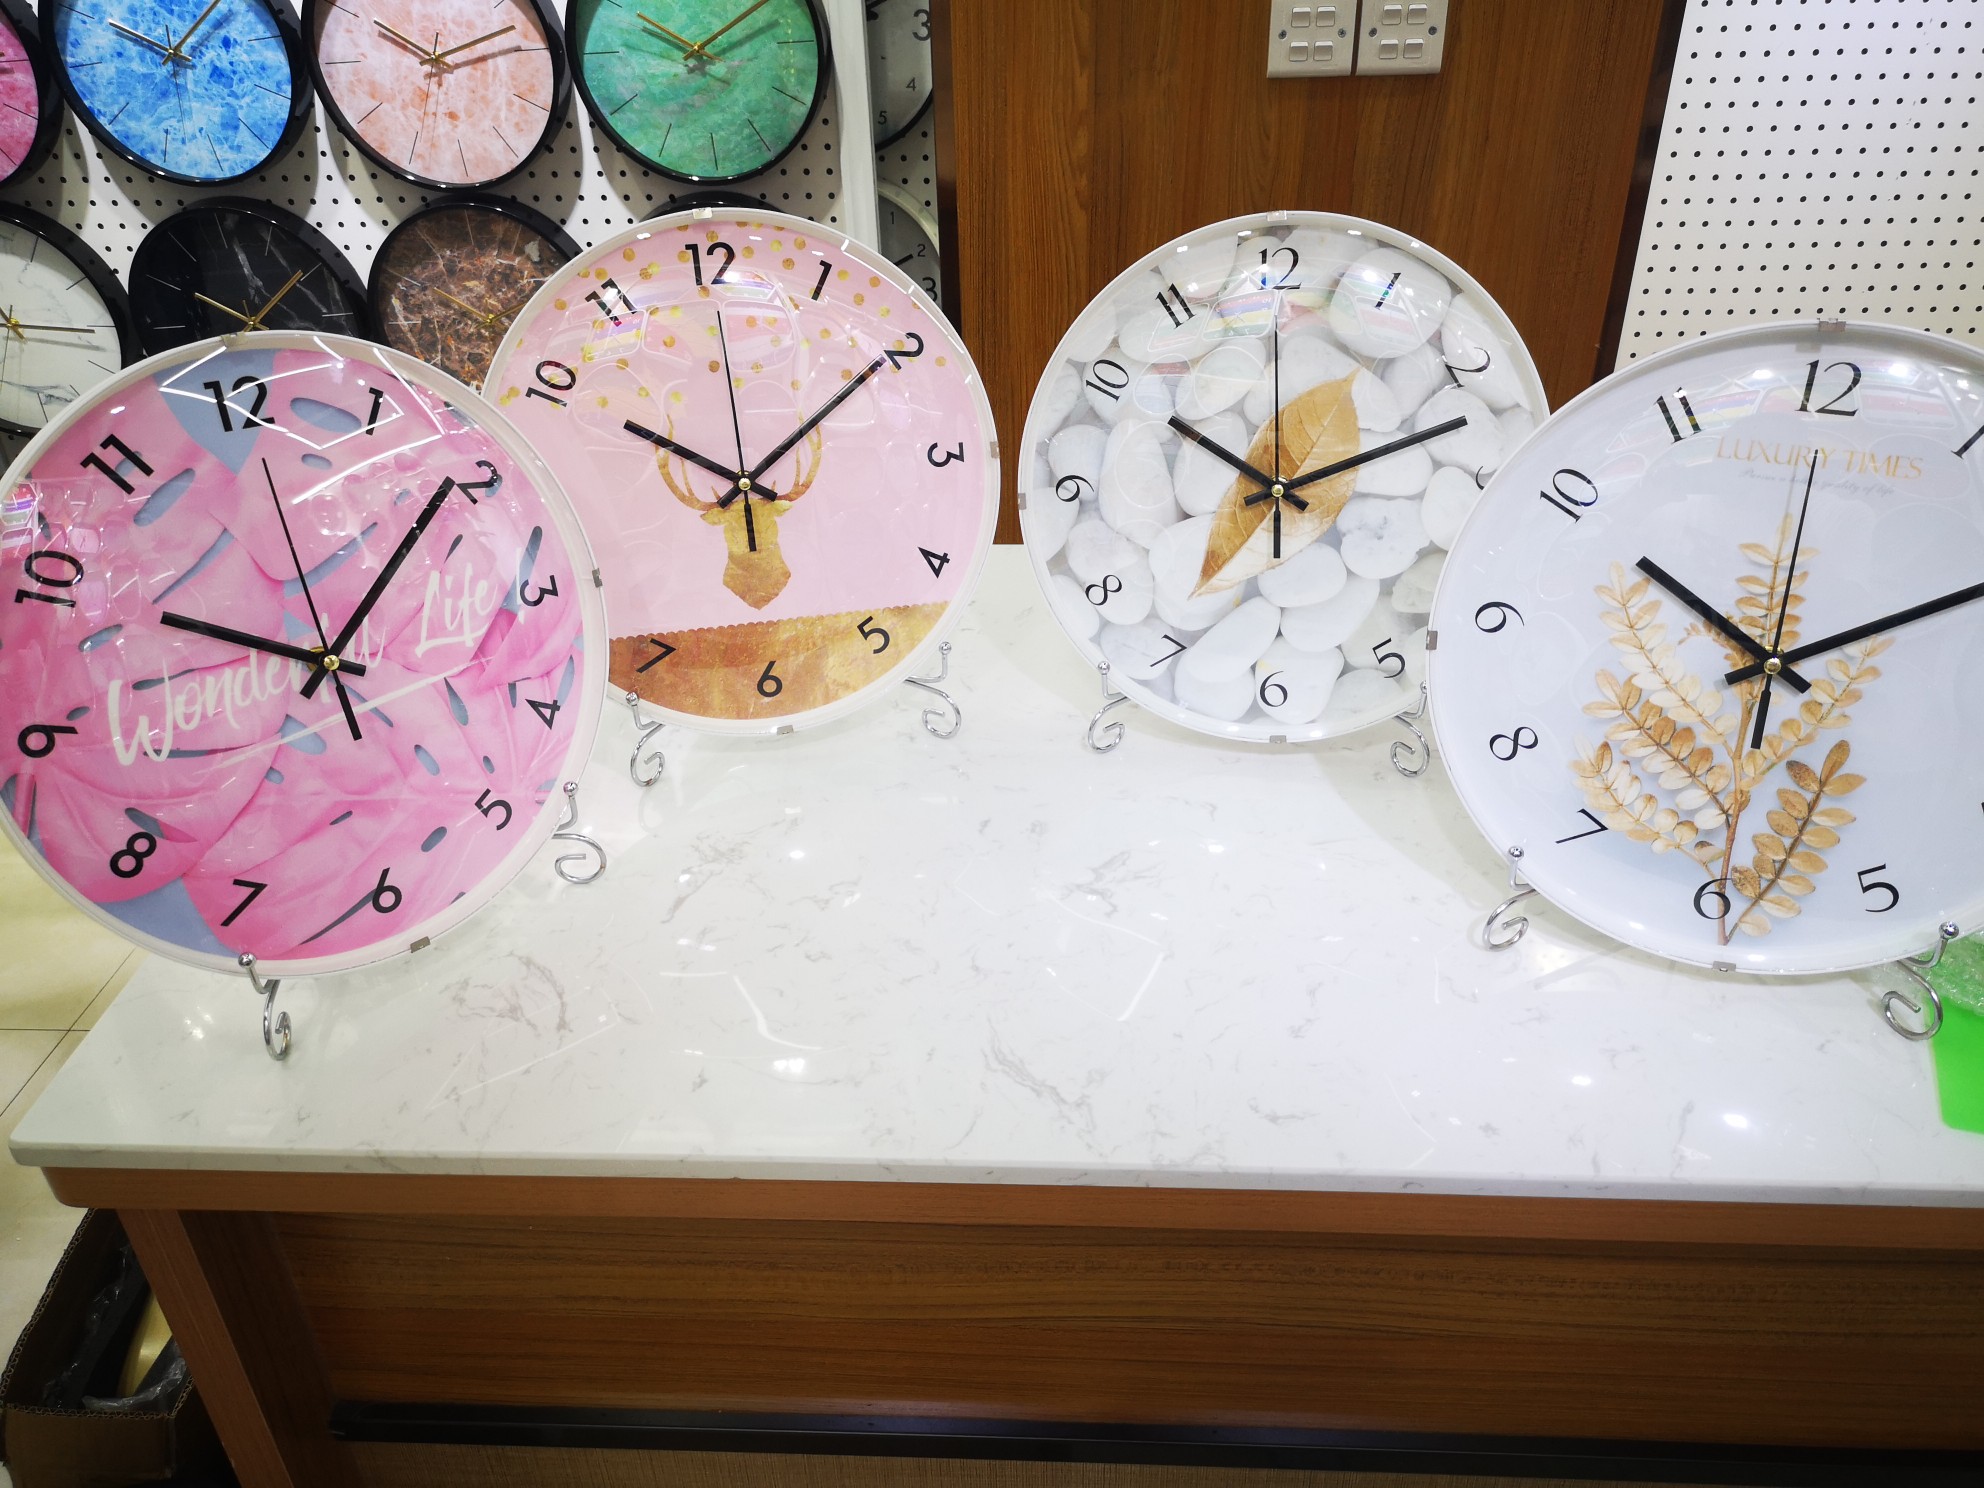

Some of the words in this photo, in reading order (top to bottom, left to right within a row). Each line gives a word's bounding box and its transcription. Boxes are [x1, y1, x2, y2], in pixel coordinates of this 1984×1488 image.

[912, 9, 931, 41] 3
[905, 77, 917, 92] 4
[877, 110, 887, 126] 5
[685, 242, 735, 285] 12
[917, 243, 926, 257] 2
[1258, 247, 1301, 291] 12
[812, 260, 832, 300] 1
[1374, 272, 1402, 309] 1
[584, 277, 638, 327] 11
[1156, 283, 1195, 328] 11
[884, 333, 923, 370] 2
[1444, 346, 1490, 389] 2
[526, 360, 576, 407] 10
[1086, 360, 1129, 400] 10
[1796, 359, 1862, 417] 12
[203, 376, 275, 432] 12
[366, 388, 383, 435] 1
[1655, 386, 1702, 445] 11
[80, 434, 154, 494] 11
[928, 443, 964, 467] 3
[1716, 435, 1836, 469] LUXURY
[1842, 449, 1924, 480] TIMES
[456, 461, 498, 504] 2
[1056, 475, 1094, 502] 9
[1540, 469, 1598, 522] 10
[14, 550, 84, 608] 10
[919, 547, 950, 578] 4
[520, 575, 559, 607] 3
[1085, 575, 1122, 605] 8
[857, 616, 889, 653] 5
[1475, 602, 1523, 633] 9
[636, 638, 676, 673] 7
[1149, 634, 1188, 668] 7
[1373, 638, 1405, 678] 5
[757, 661, 782, 697] 6
[1259, 670, 1288, 707] 6
[526, 700, 560, 729] 4
[18, 725, 78, 758] 9
[1490, 727, 1538, 760] 8
[475, 789, 511, 830] 5
[1555, 808, 1609, 845] 7
[110, 832, 156, 878] 8
[221, 879, 267, 926] 7
[372, 868, 401, 913] 6
[1694, 876, 1730, 919] 6
[1858, 864, 1899, 912] 5
